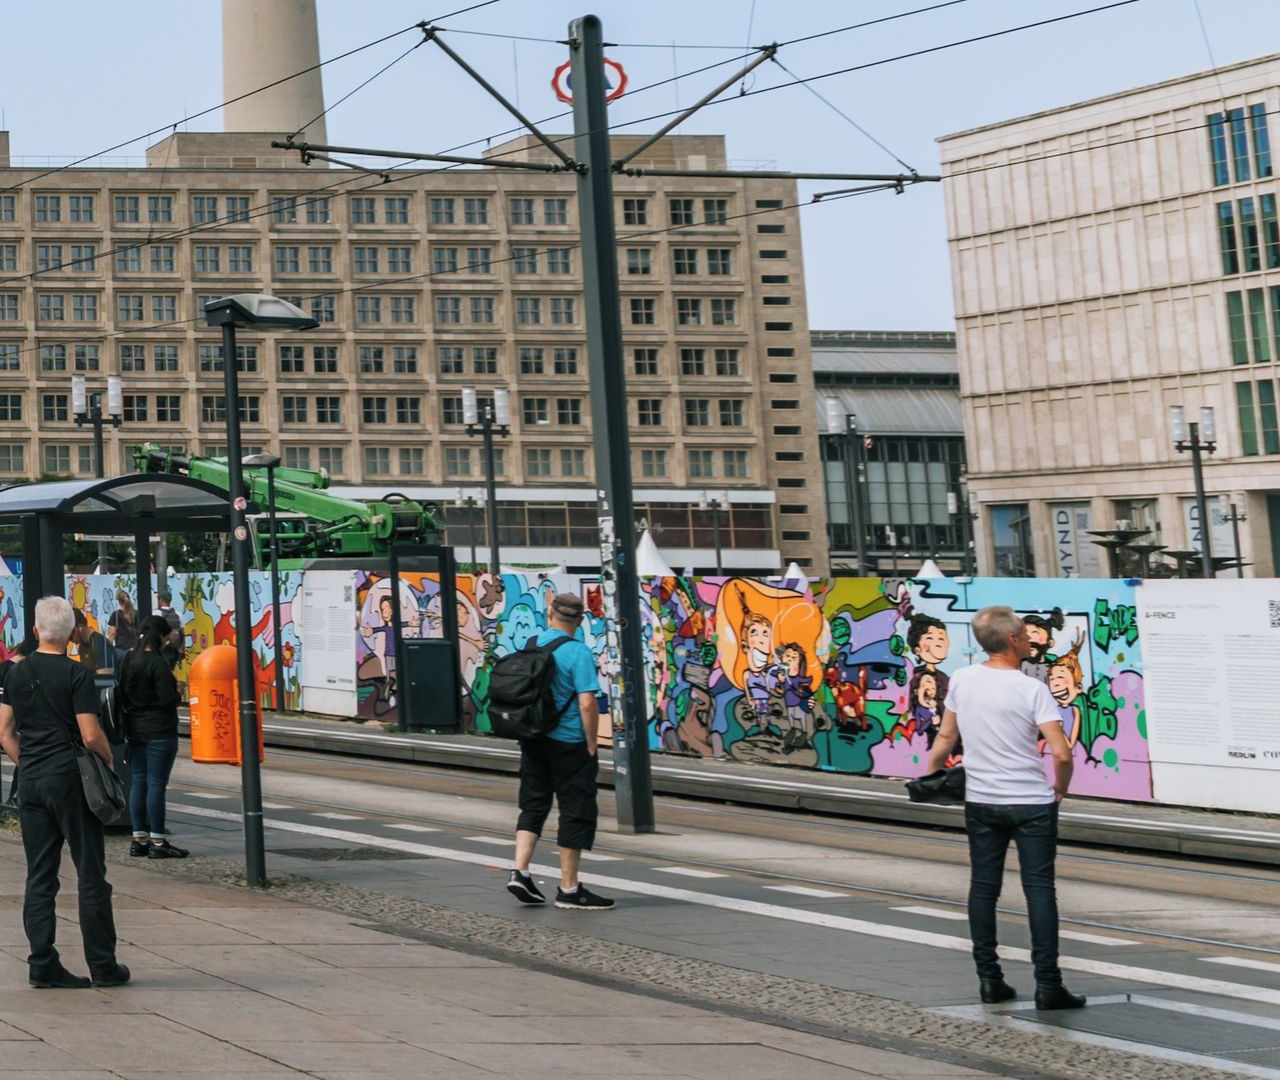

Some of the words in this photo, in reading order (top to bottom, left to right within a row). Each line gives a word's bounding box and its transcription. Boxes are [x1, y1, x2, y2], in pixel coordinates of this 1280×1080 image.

[1093, 597, 1139, 655] ENDE
[1228, 751, 1256, 759] BERLIN
[1263, 750, 1280, 759] CO
